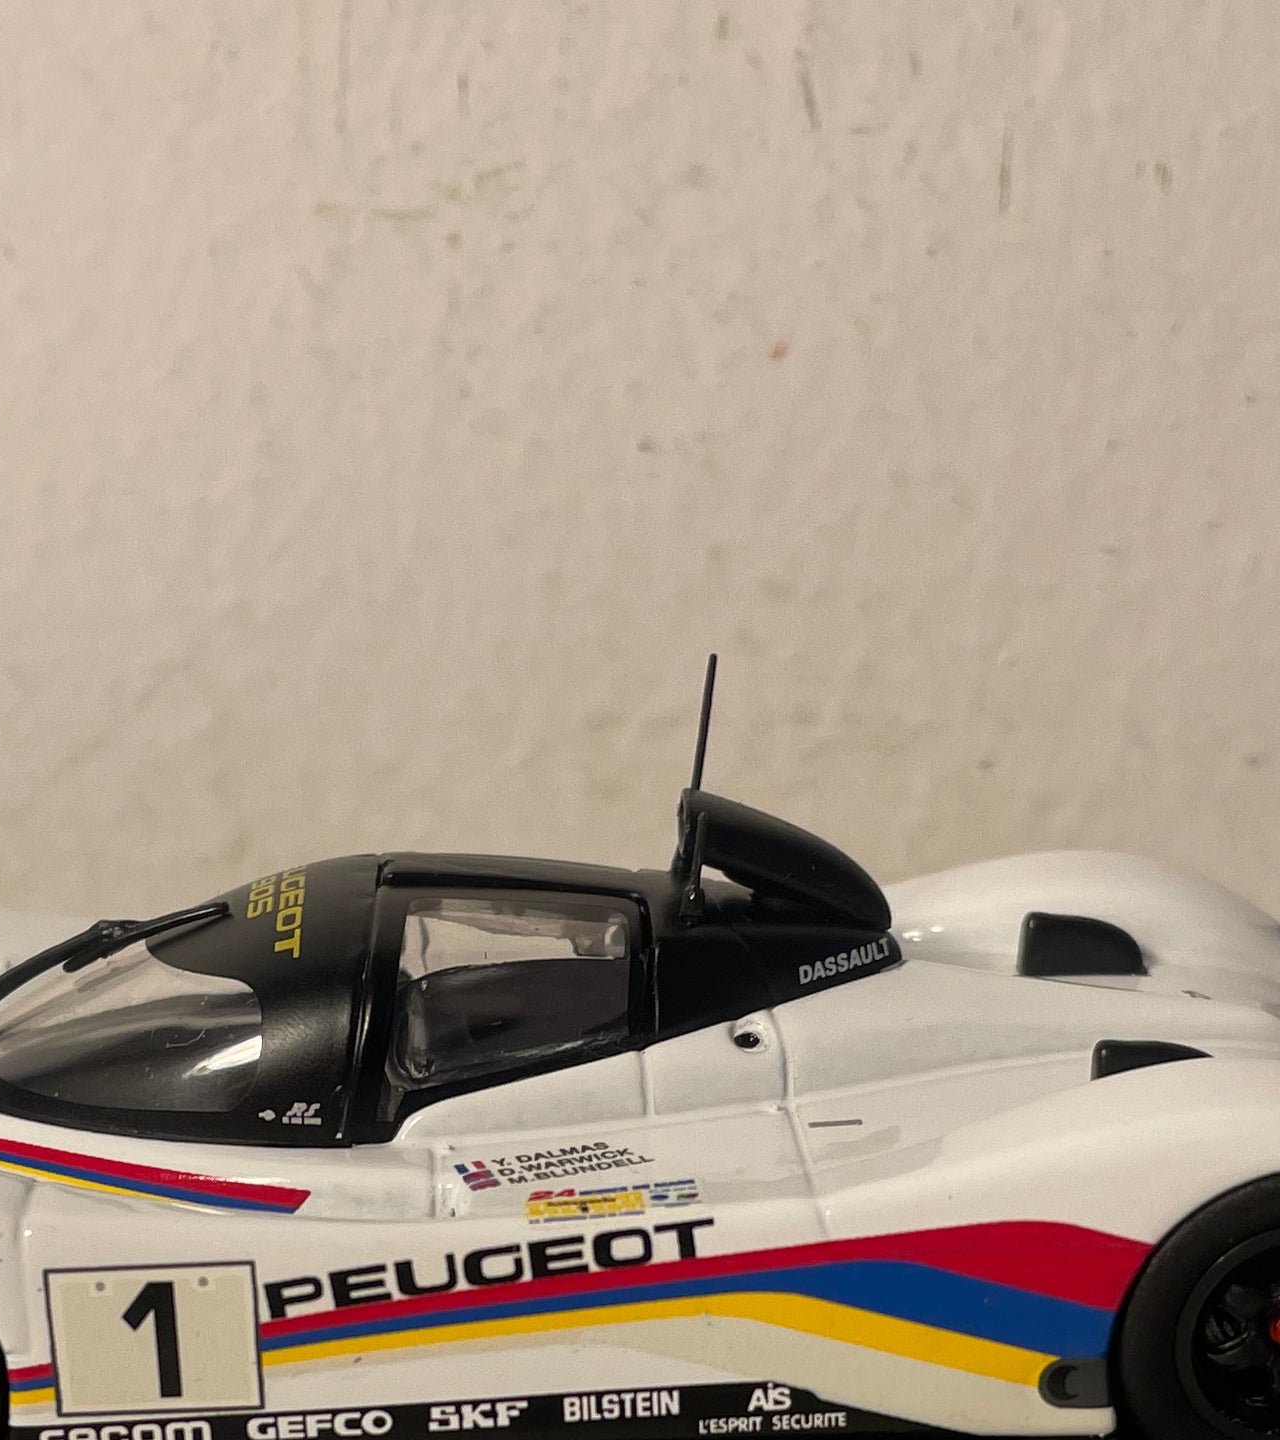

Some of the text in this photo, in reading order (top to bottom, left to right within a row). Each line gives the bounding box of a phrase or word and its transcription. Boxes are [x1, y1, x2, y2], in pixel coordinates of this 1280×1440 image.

[798, 937, 890, 985] DASSAULT
[496, 1147, 636, 1178] D.WARWICK
[516, 1141, 610, 1164] DALMAS
[506, 1154, 655, 1186] M.BLUNDELL
[264, 1217, 717, 1321] PEUGEOT
[121, 1281, 184, 1399] 1
[428, 1400, 529, 1432] SKF
[563, 1389, 681, 1423] BILSTEIN
[246, 1410, 393, 1440] GEFCO
